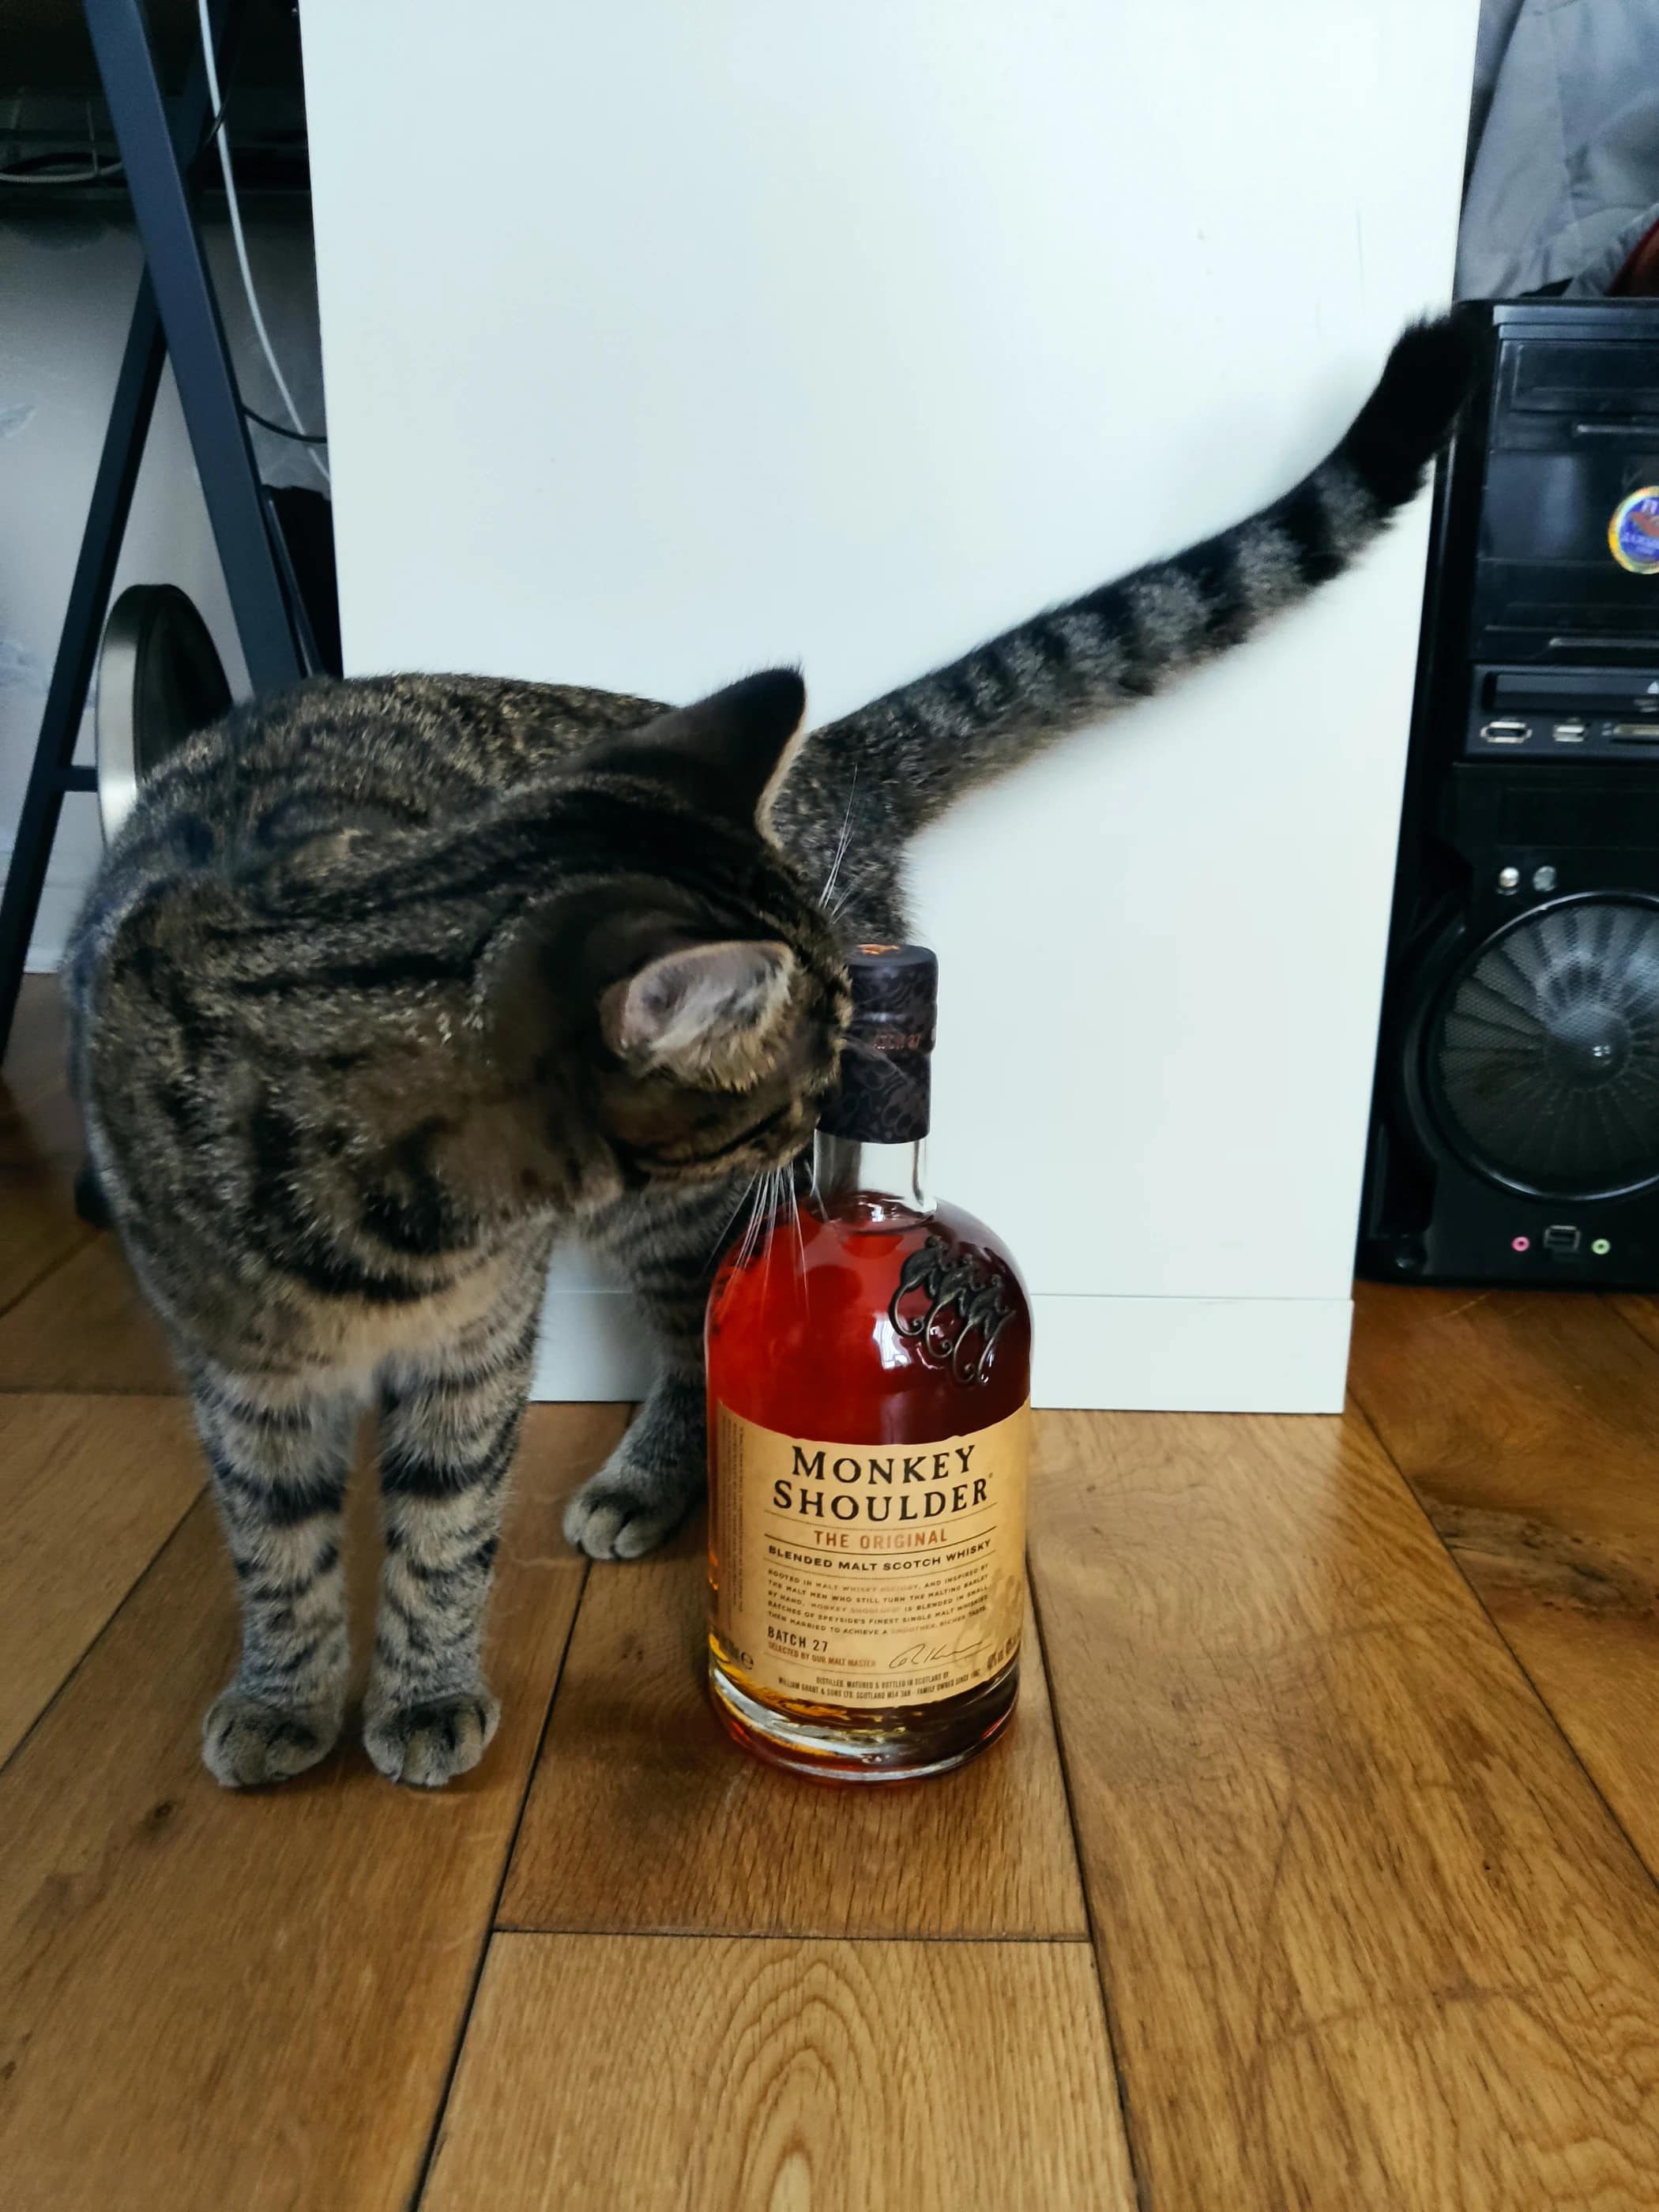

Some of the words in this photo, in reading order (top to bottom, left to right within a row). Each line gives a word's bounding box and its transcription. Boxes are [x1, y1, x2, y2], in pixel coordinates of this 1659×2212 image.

[792, 1445, 975, 1484] MONKEY
[773, 1477, 988, 1522] SHOULDER
[814, 1530, 849, 1548] THE
[860, 1529, 947, 1549] ORIGINAL
[769, 1545, 833, 1568] BLENDED
[838, 1561, 878, 1571] MALT
[883, 1556, 941, 1571] SCOTCH
[946, 1539, 991, 1562] WHISKY
[769, 1569, 799, 1583] ROOTED
[816, 1582, 838, 1591] MALT
[945, 1568, 978, 1583] INSPIRED
[769, 1580, 782, 1589] THE
[786, 1586, 806, 1595] MALT
[928, 1586, 961, 1597] MALTING
[964, 1574, 988, 1588] BARLEY
[916, 1598, 953, 1610] BLENDED
[967, 1586, 988, 1597] SMALL
[768, 1601, 801, 1616] BATCHES
[818, 1615, 866, 1623] SPEYSIDE'S
[902, 1613, 931, 1622] SINGLE
[935, 1608, 954, 1618] MALT
[769, 1611, 787, 1622] THEN
[790, 1618, 826, 1631] MARRIED
[939, 1615, 965, 1627] RICHER
[768, 1626, 807, 1649] BATCH
[813, 1639, 828, 1653] 27
[769, 1642, 799, 1658] SELECTED
[828, 1657, 846, 1666] MALT
[848, 1659, 876, 1668] MASTER
[778, 1676, 799, 1690] WILLIAM
[802, 1683, 818, 1694] GRANT
[827, 1688, 841, 1698] SONS
[915, 1673, 942, 1685] SCOTLAND
